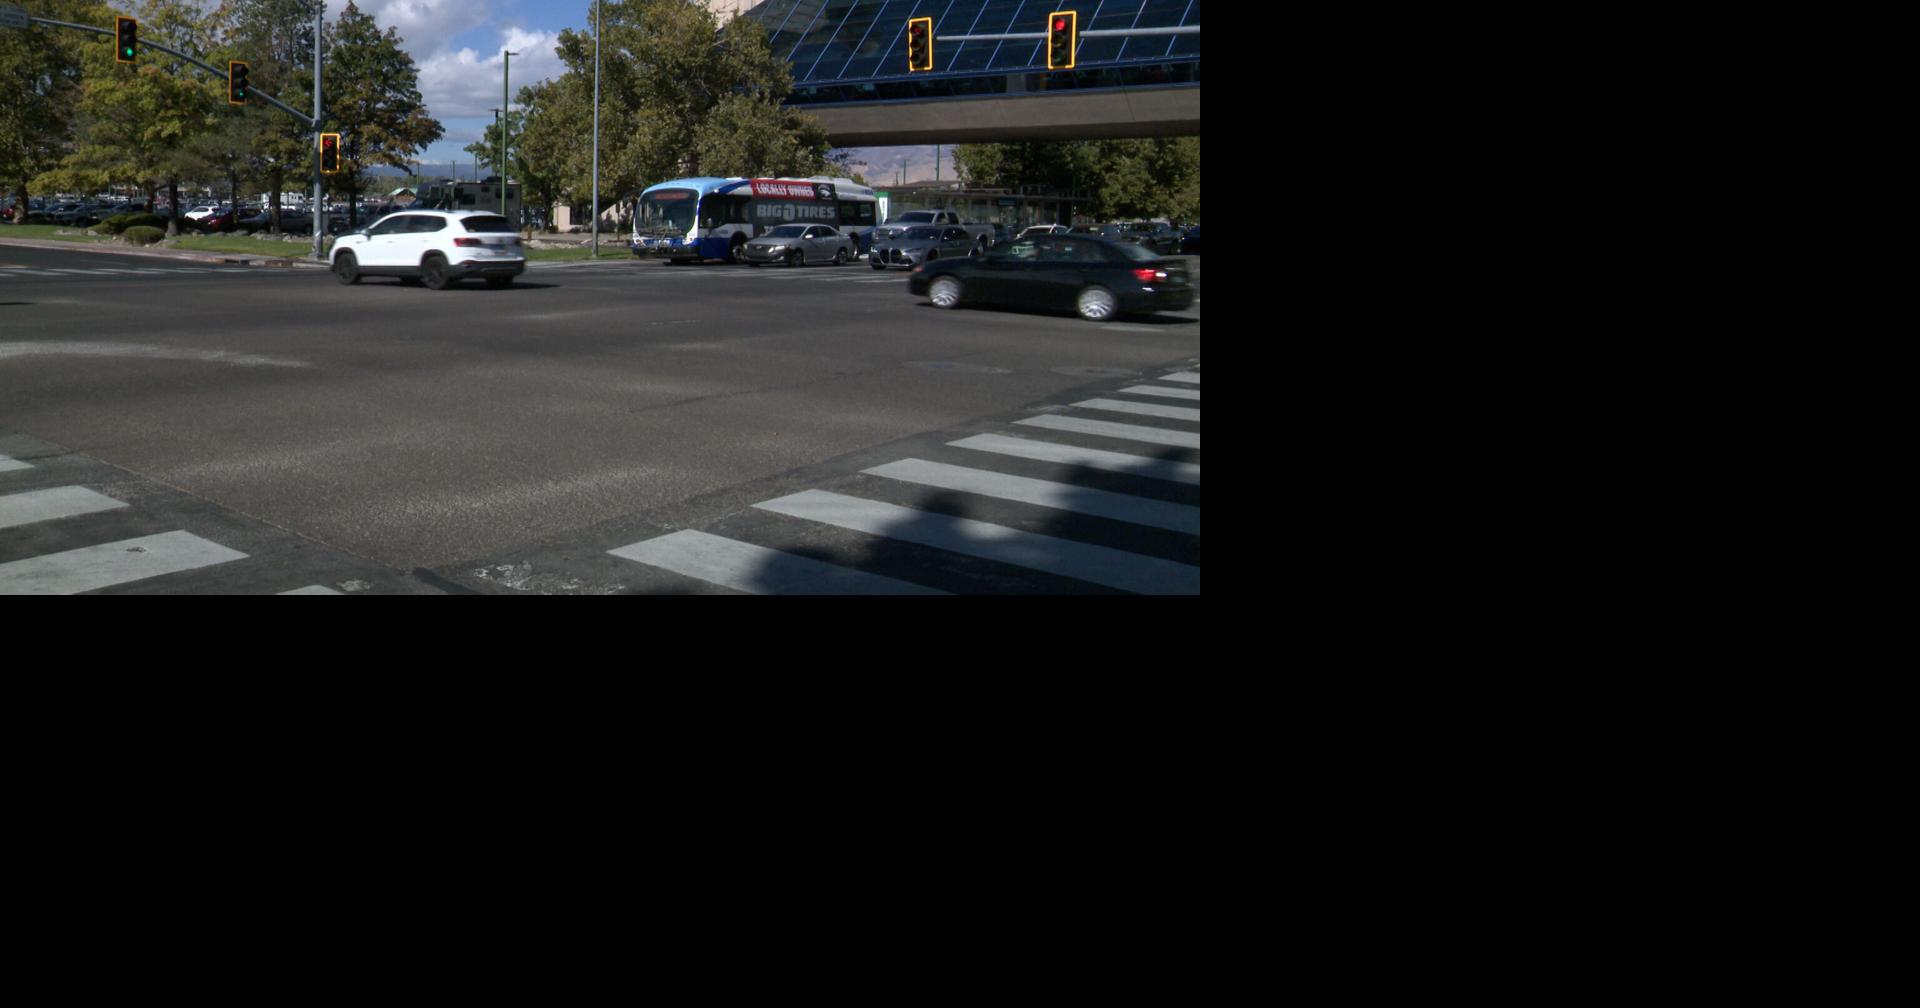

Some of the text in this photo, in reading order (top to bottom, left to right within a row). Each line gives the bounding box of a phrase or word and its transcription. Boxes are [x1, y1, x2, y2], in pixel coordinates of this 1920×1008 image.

[756, 183, 787, 196] LOCALLY
[787, 185, 814, 197] OWNED
[757, 204, 782, 217] BIG
[797, 205, 835, 218] TIRES
